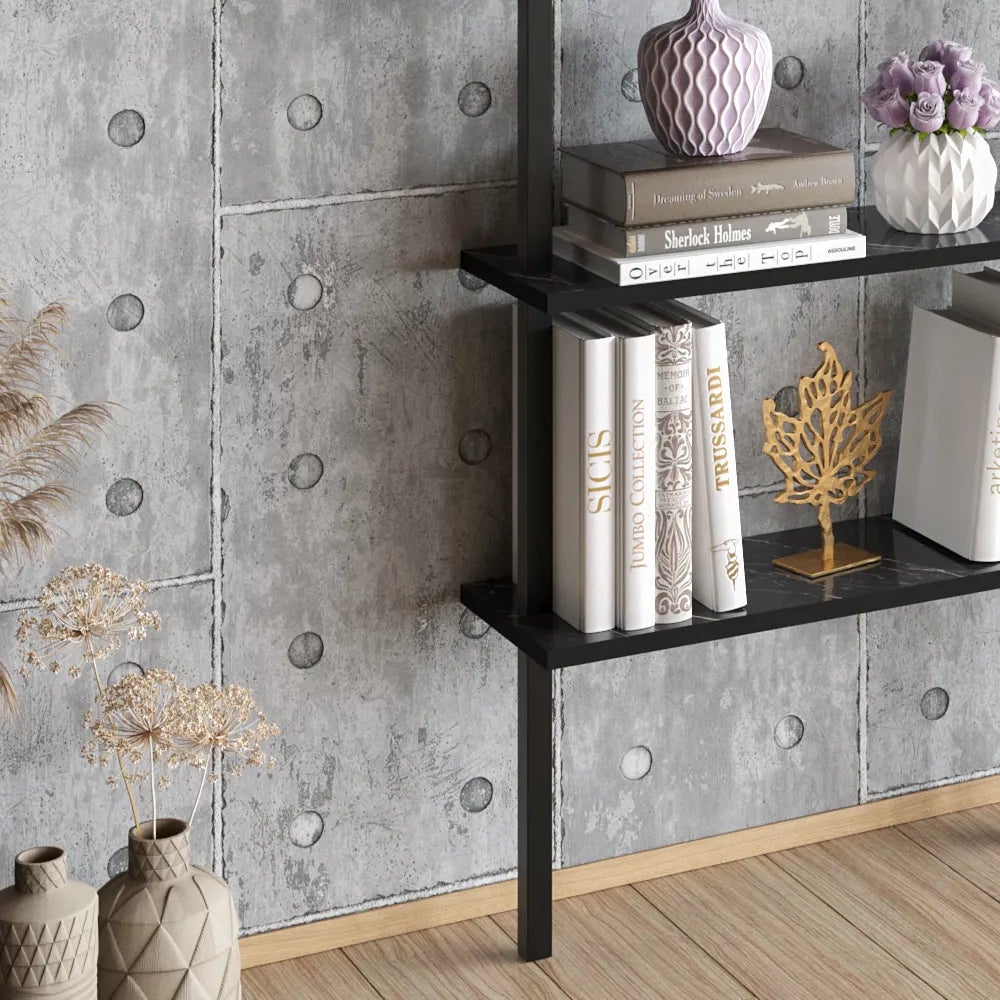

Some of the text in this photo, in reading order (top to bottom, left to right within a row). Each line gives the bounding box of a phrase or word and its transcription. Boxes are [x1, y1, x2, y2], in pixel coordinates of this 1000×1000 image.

[653, 187, 743, 205] Dreaming of Sweden
[664, 224, 752, 250] Sherlock Holmes
[829, 214, 841, 235] DOYLE
[629, 250, 809, 280] Over the Top
[706, 366, 730, 491] TRUSSARDI
[587, 429, 612, 514] SICIS
